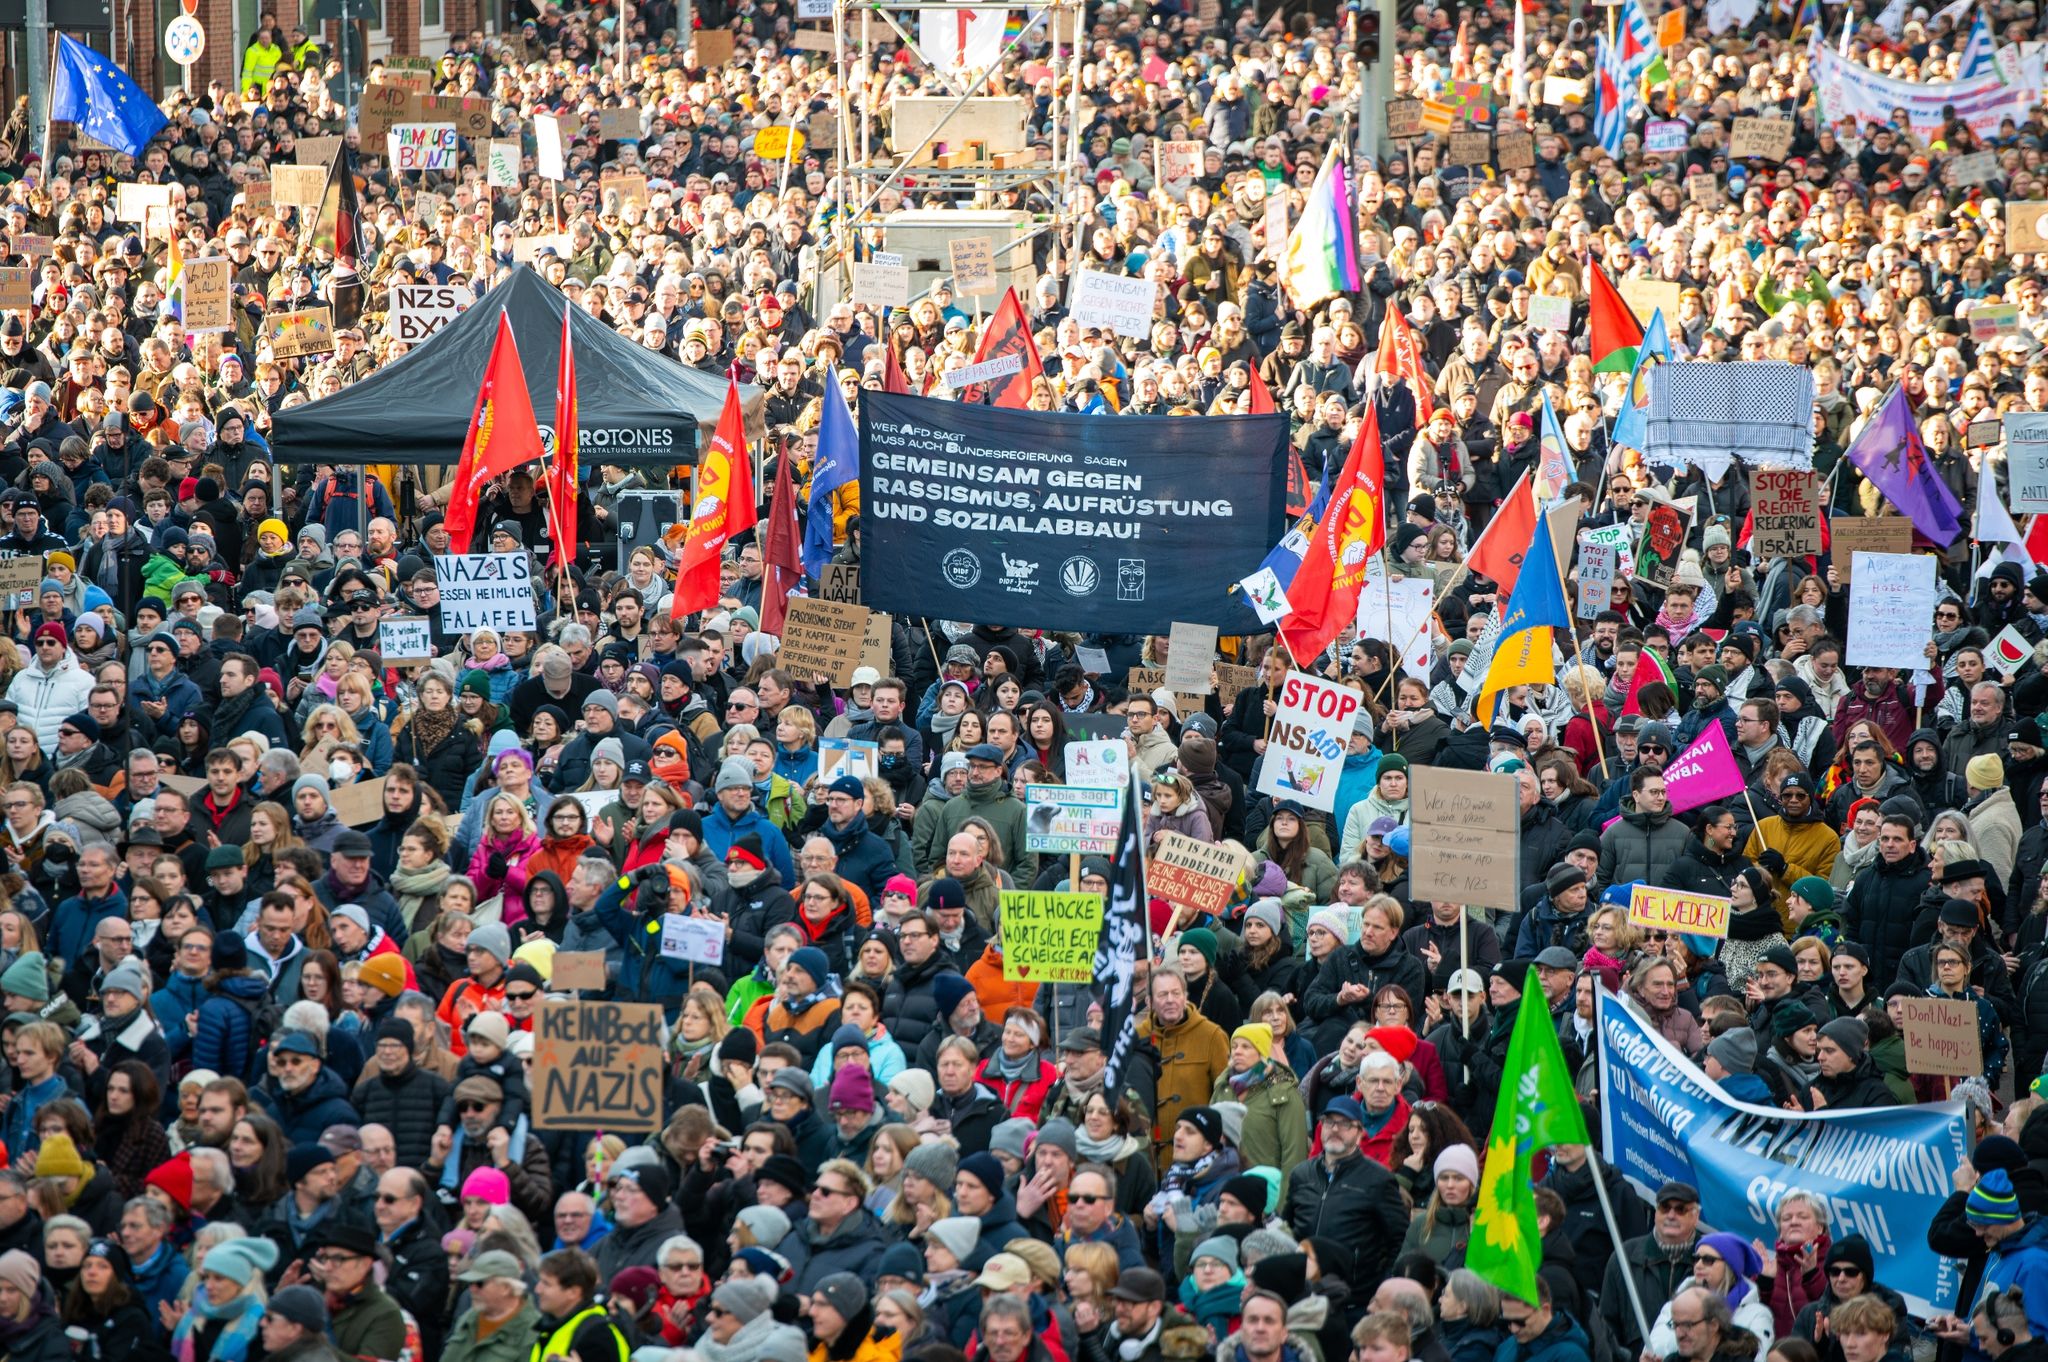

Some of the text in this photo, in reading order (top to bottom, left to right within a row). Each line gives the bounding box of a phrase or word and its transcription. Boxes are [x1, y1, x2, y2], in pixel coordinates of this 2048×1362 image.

[393, 128, 456, 148] HAMBURG
[400, 148, 457, 168] BUNT
[1086, 275, 1147, 296] GEMEINSAM
[400, 288, 456, 310] NZS
[1078, 311, 1141, 331] NIE WIEDER
[871, 421, 898, 434] WER
[933, 429, 966, 442] SAGT
[871, 433, 1127, 468] MUSS AUCH BUNDESREGIERUNG SAGEN
[872, 452, 1142, 491] GEMEINSAM GEGEN
[1755, 471, 1817, 491] STOPPT
[872, 476, 1232, 517] RASSISMUS, AUFRÜSTUNG
[1779, 488, 1803, 501] DIE
[1758, 500, 1811, 515] RECHTE
[872, 500, 1141, 539] UND SOZIALABBAU!
[1755, 515, 1816, 530] REGIERUNG
[1590, 529, 1620, 544] STOP
[1784, 531, 1795, 541] IN
[1583, 545, 1608, 556] STOP
[1760, 539, 1816, 554] ISRAEL
[437, 555, 528, 581] NAZIS
[952, 567, 970, 575] DIDF
[1581, 567, 1608, 580] AFD
[440, 586, 532, 601] ESSEN HEIMLICH
[806, 602, 845, 615] HINTER DEM
[1583, 610, 1597, 618] AF
[382, 622, 422, 637] Nie wieder
[442, 610, 534, 629] FALAFEL
[789, 609, 857, 631] FASCHISMUS STEHT
[787, 626, 837, 643] DAS KAPITAL
[785, 637, 847, 657] DER KAMPF UM
[783, 650, 846, 671] BEFREIUNG IST
[1283, 678, 1357, 722] STOP
[1309, 728, 1341, 761] AfD
[1423, 789, 1446, 811] Wer
[1067, 807, 1093, 819] WIR
[1055, 821, 1119, 837] ALLE FÜR
[1167, 836, 1200, 854] NU IS
[1474, 854, 1492, 867] AfD
[1149, 862, 1228, 896] MEINE FREUNDE
[1433, 871, 1488, 891] FCK NZS
[1147, 875, 1222, 911] BLEIBEN HIER!
[1633, 895, 1658, 920] NIE
[1003, 921, 1100, 948] HÖRT ECHT
[542, 1004, 604, 1043] KEIN
[1907, 1003, 1961, 1028] Don't Nazi
[1910, 1031, 1959, 1059] Be happy
[570, 1045, 620, 1068] AUF
[1603, 1014, 1713, 1104] Mieterverein
